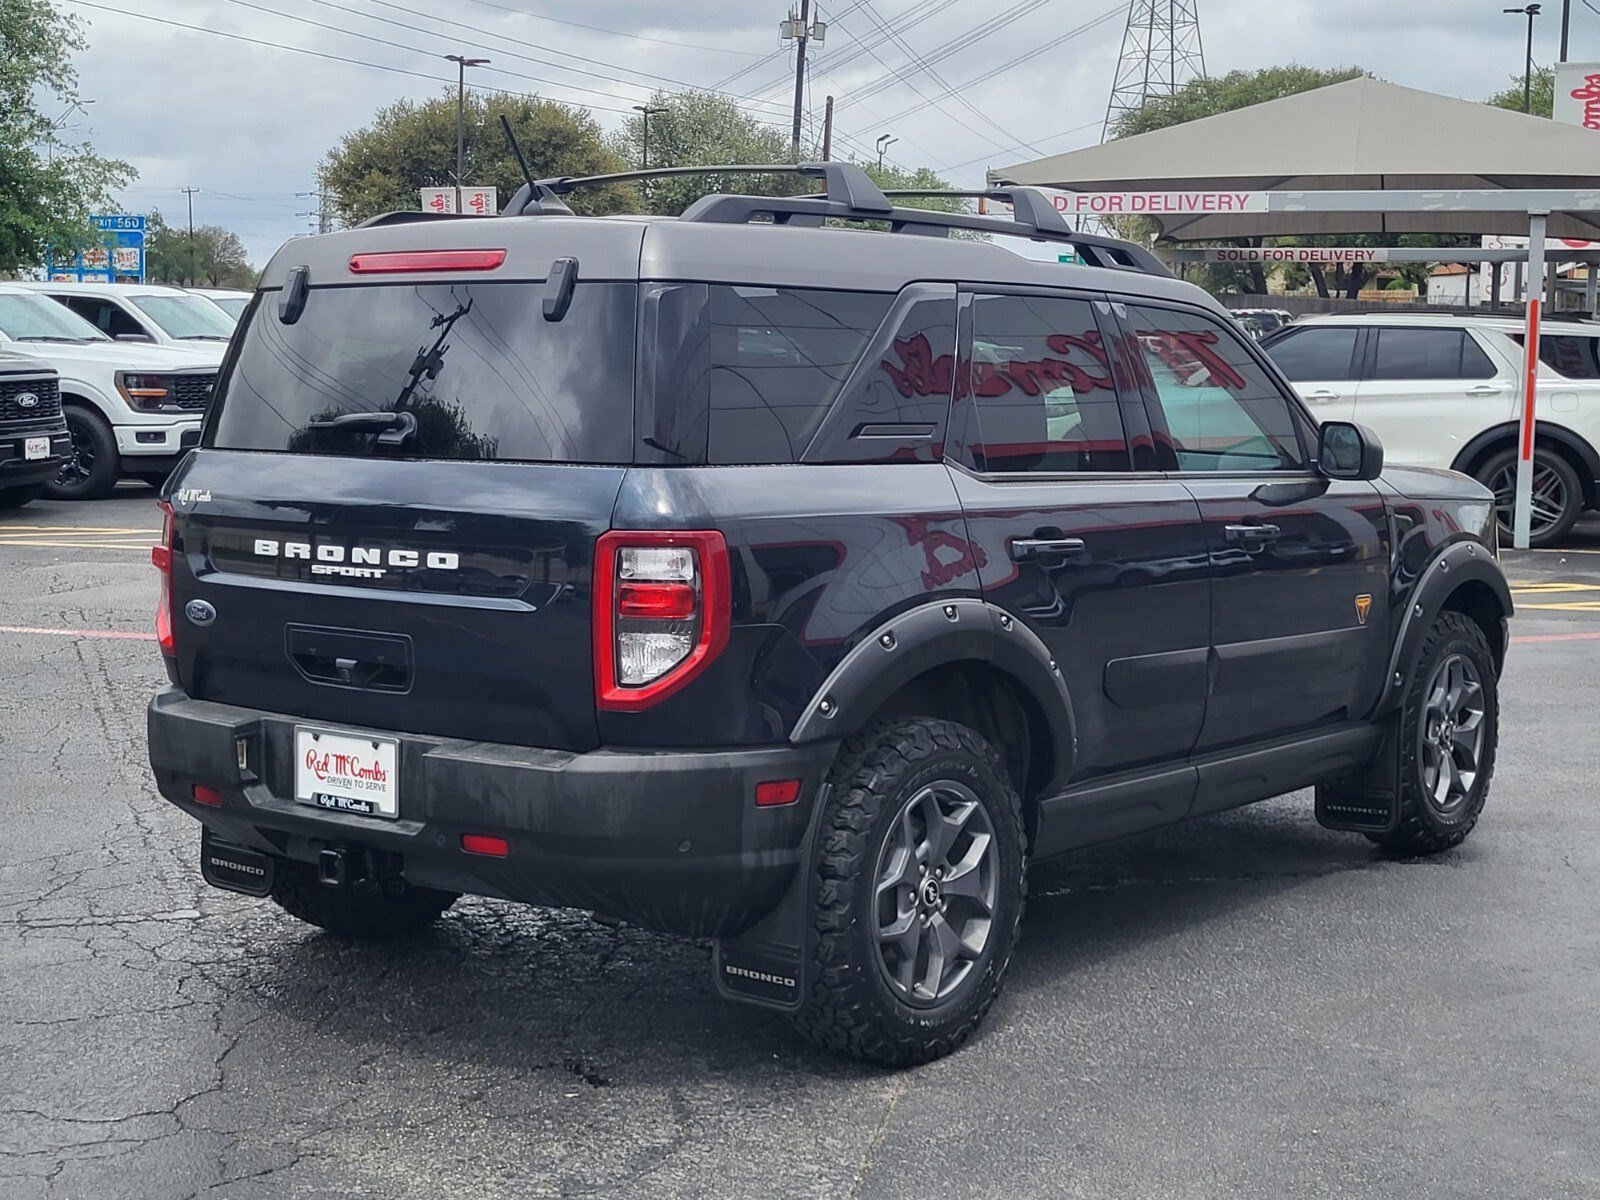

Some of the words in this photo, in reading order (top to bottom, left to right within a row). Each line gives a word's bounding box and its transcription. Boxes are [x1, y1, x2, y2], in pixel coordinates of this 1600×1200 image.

[1076, 195, 1123, 212] FOR
[1131, 194, 1250, 211] DELIVERY
[117, 217, 140, 229] 560
[1217, 250, 1259, 261] SOLD
[1263, 250, 1294, 261] FOR
[1300, 250, 1375, 261] DELIVERY
[254, 539, 460, 570] BRONCO
[311, 564, 387, 579] SPORT
[306, 748, 330, 780] Red
[331, 753, 387, 781] McCombs
[327, 776, 353, 787] DRIVEN
[354, 779, 364, 789] TO
[365, 781, 387, 793] SERVE
[320, 794, 336, 808] Red
[211, 857, 265, 876] BRONCO
[726, 965, 796, 988] BRONCO
